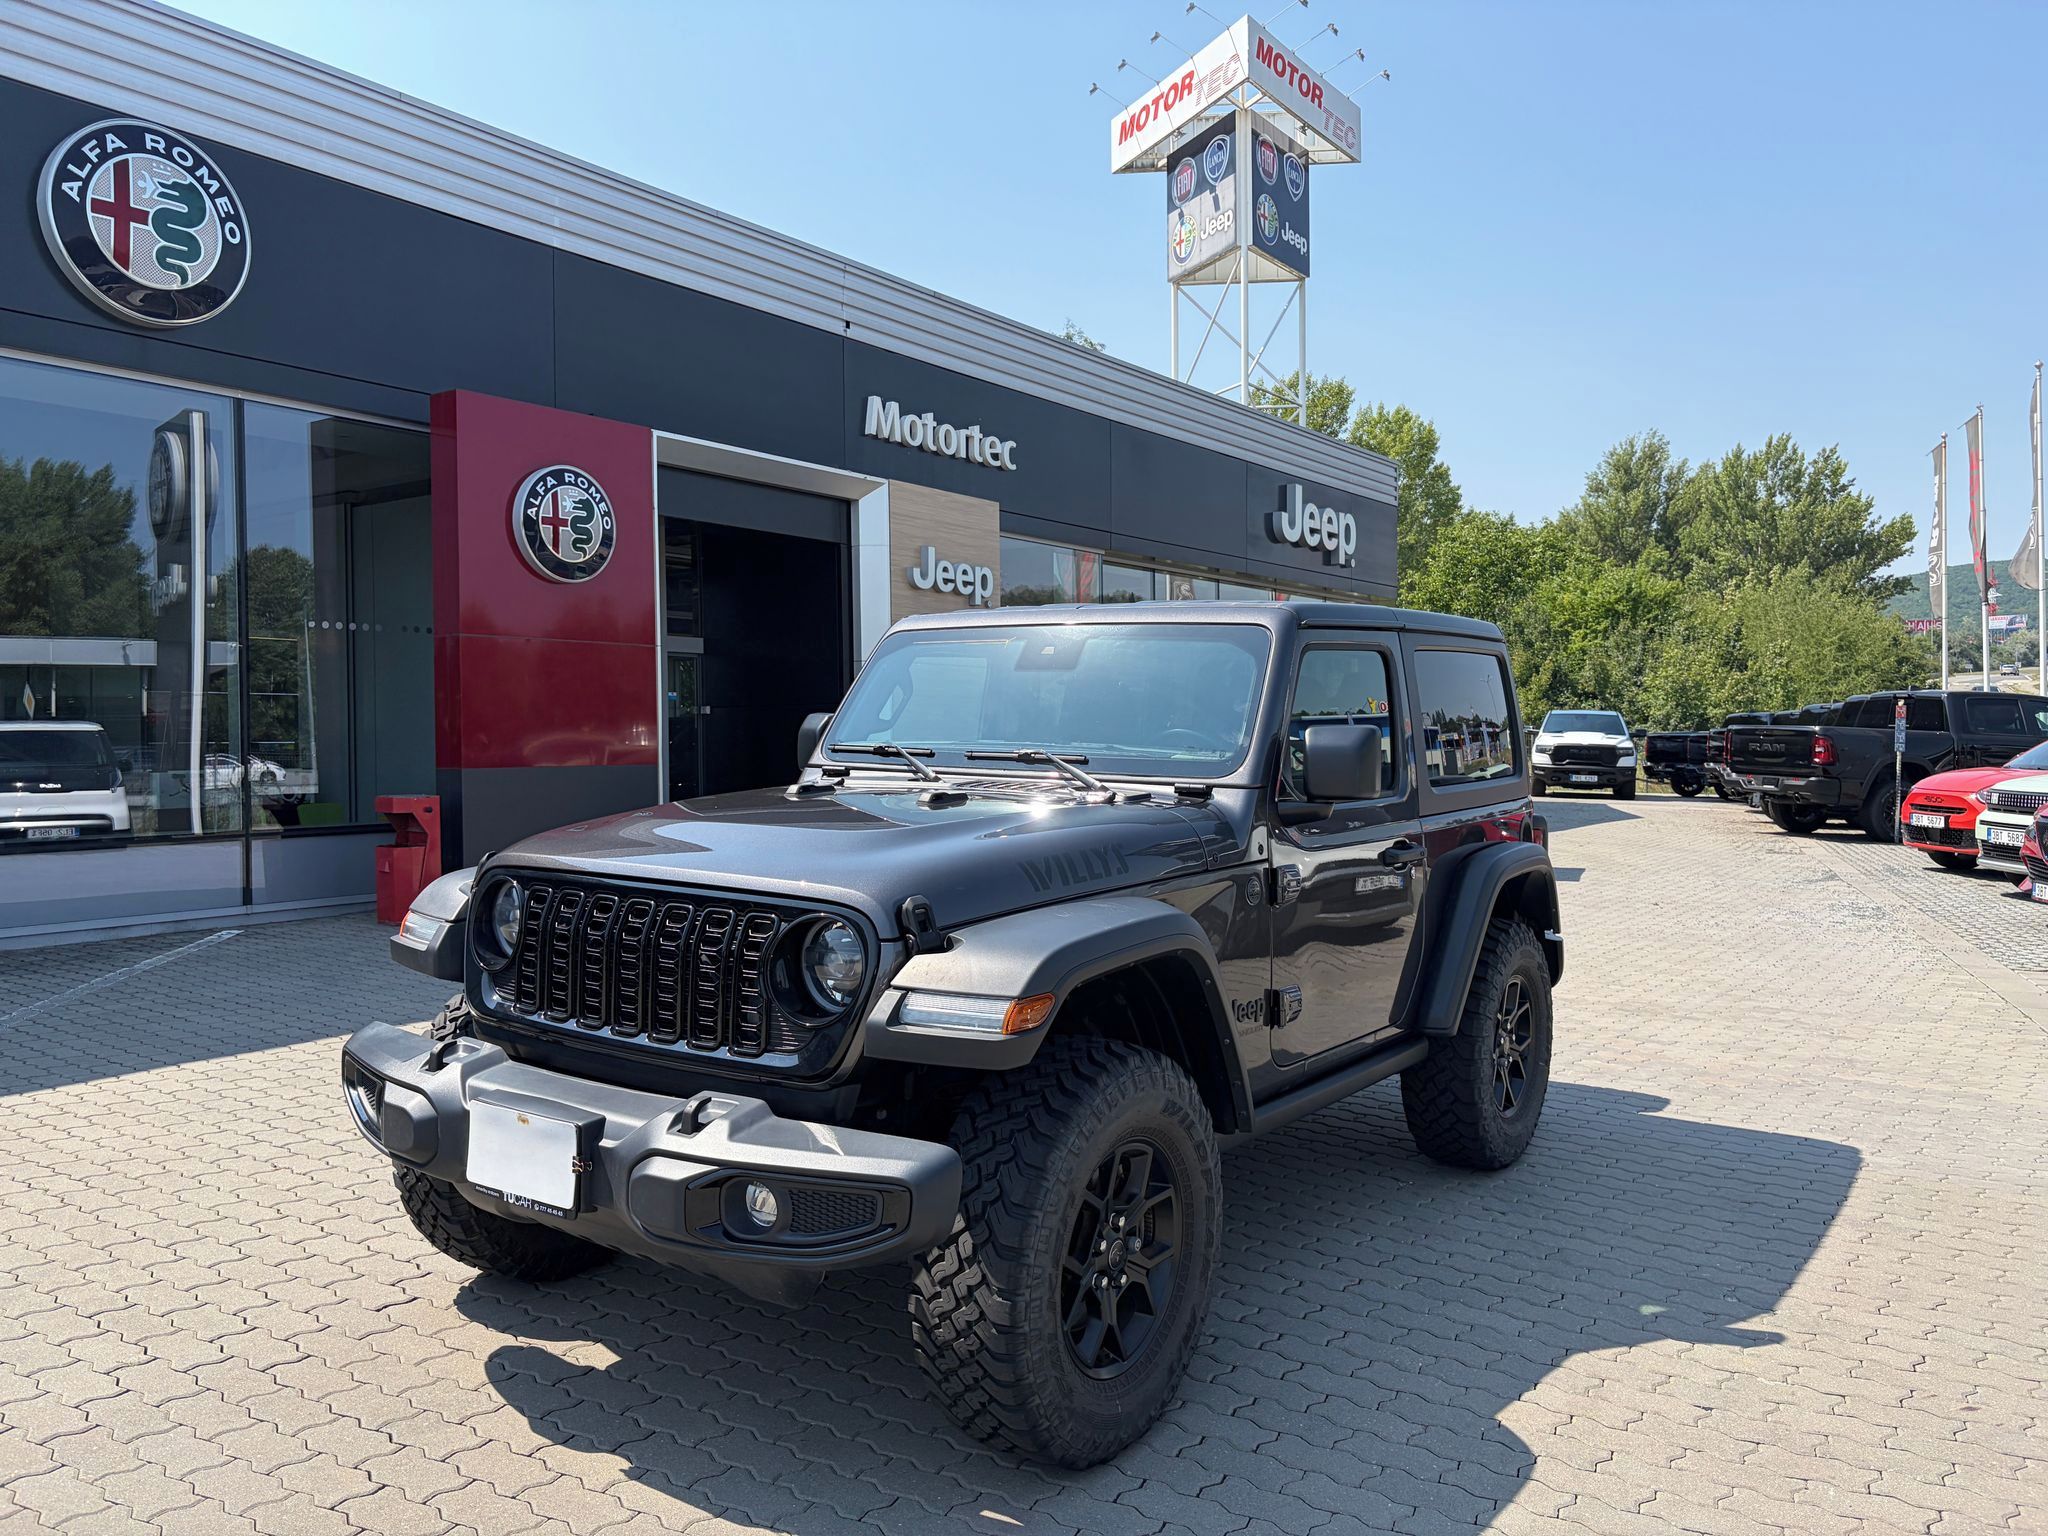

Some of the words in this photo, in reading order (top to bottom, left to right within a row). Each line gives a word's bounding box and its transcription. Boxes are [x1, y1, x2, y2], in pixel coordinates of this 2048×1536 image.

[1118, 70, 1195, 146] MOTOR
[1194, 53, 1240, 106] TEC
[1256, 35, 1323, 109] MOTOR
[1322, 107, 1357, 149] TEC
[61, 133, 128, 203] ALFA
[143, 132, 241, 245] ROMEO
[1177, 169, 1192, 197] FIAT
[1261, 147, 1275, 174] FIAT
[1200, 209, 1233, 240] Jeep
[1281, 221, 1308, 255] Jeep
[864, 395, 1017, 471] Motortec
[527, 476, 558, 520] ALFA
[564, 472, 611, 530] ROMEO
[1273, 483, 1356, 566] Jeep
[908, 545, 994, 606] Jeep
[1017, 843, 1130, 892] WILLYS
